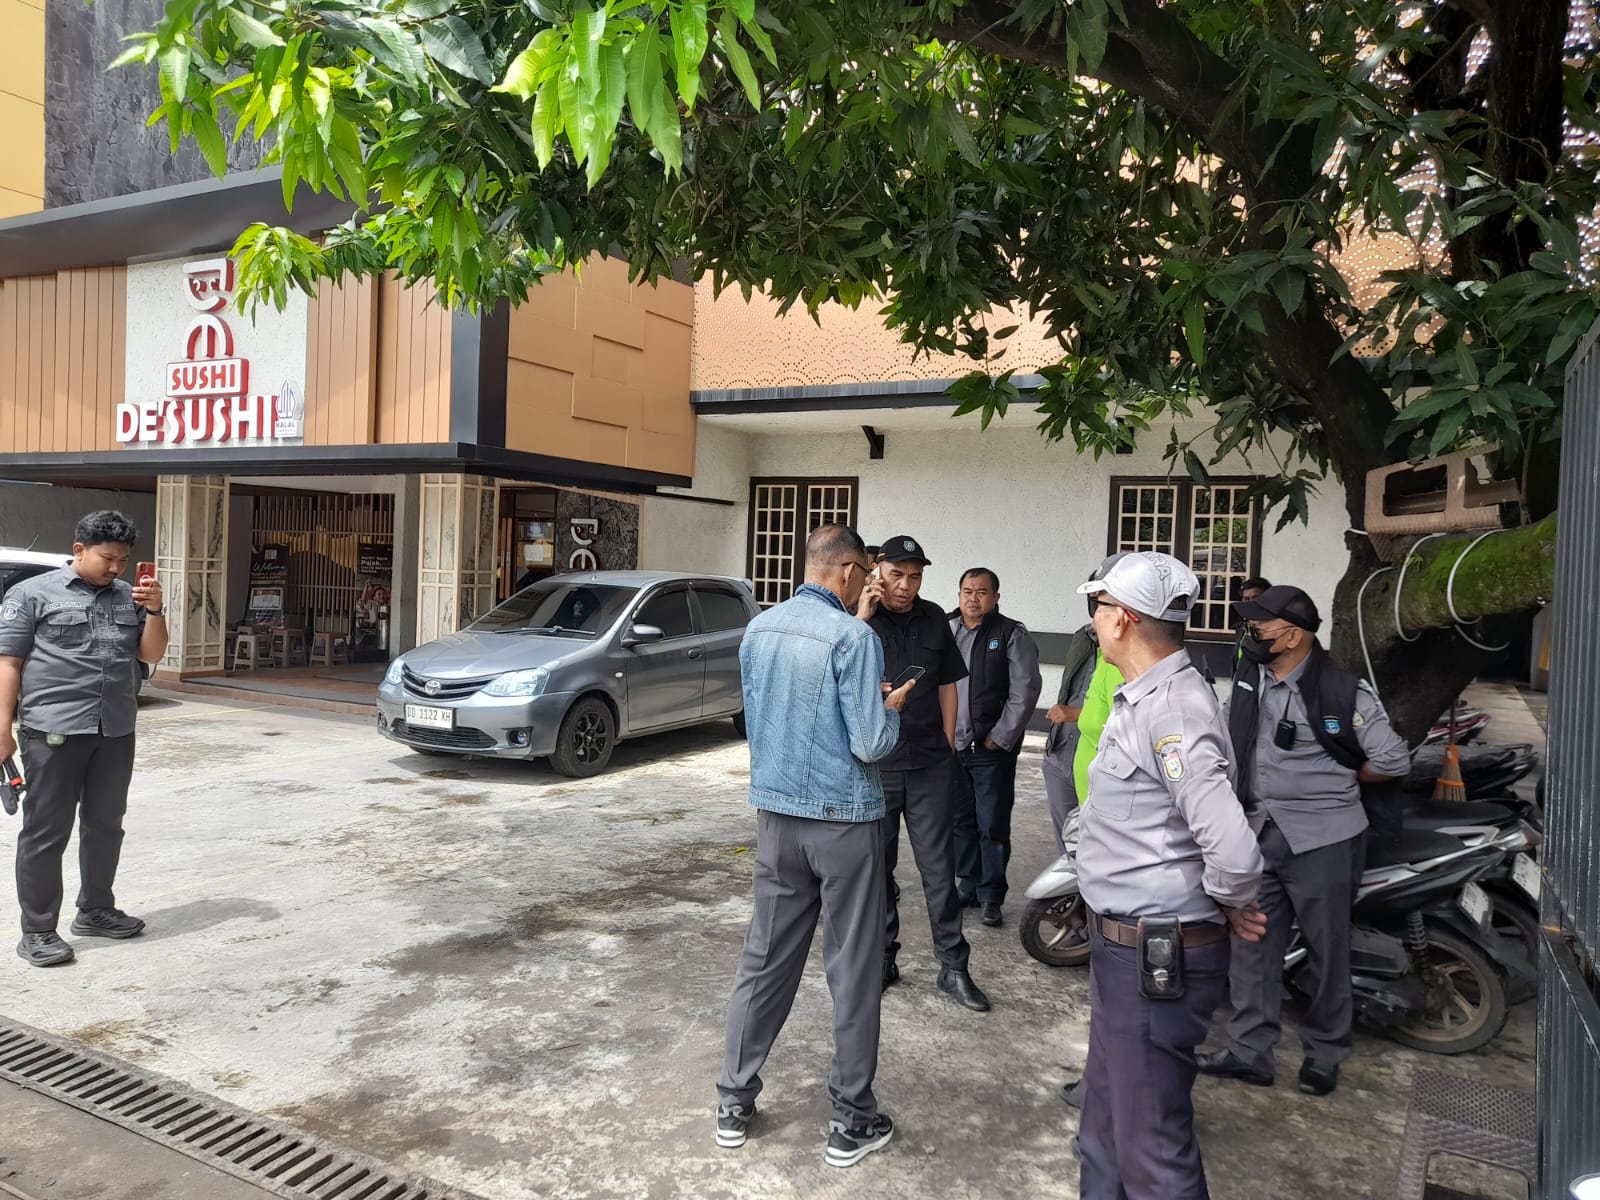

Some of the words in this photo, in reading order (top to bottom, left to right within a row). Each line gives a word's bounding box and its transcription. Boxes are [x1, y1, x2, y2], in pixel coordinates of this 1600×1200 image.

[172, 364, 235, 391] SUSHI
[116, 395, 274, 443] DE'SUSHI
[419, 708, 438, 721] 1122
[441, 711, 451, 722] XH
